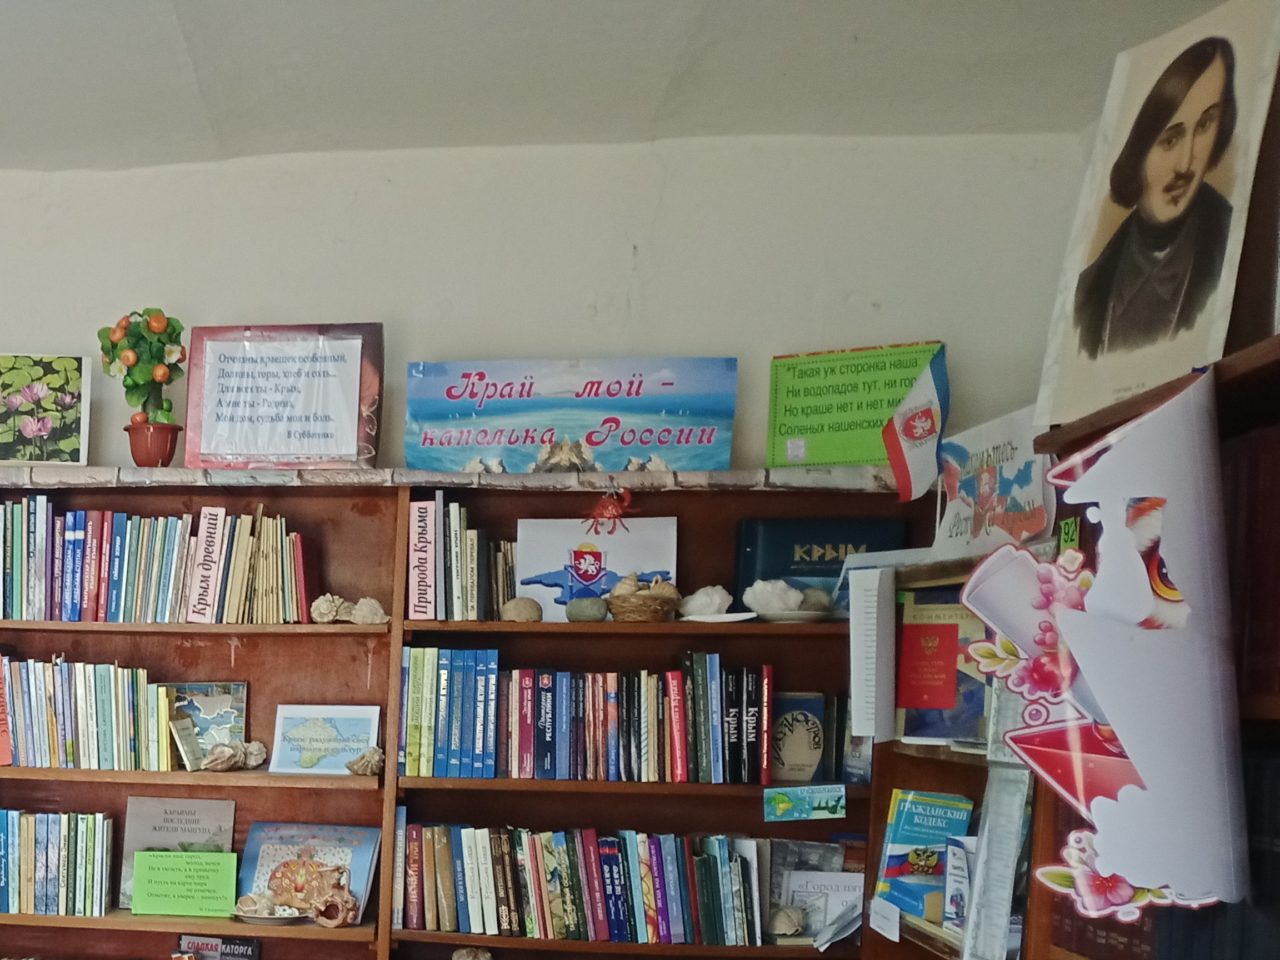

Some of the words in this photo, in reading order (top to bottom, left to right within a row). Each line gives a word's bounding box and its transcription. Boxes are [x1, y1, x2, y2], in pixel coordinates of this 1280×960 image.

[824, 367, 836, 379] уж
[839, 363, 887, 376] сторонка
[445, 370, 535, 409] Край
[574, 373, 644, 398] мой
[786, 386, 800, 398] Ни
[804, 383, 858, 397] водопадов
[884, 378, 896, 388] ни
[784, 405, 798, 417] Но
[802, 404, 833, 418] краше
[837, 402, 853, 412] нет
[857, 402, 863, 410] и
[866, 399, 883, 410] нет
[420, 429, 556, 447] капелька
[585, 416, 718, 447] России
[779, 423, 824, 436] Соленых
[828, 419, 884, 432] нашенских
[200, 508, 223, 567] древний
[413, 506, 432, 554] Крыма
[1062, 521, 1077, 544] 92
[191, 570, 215, 618] Крым
[412, 557, 432, 615] Природа
[727, 708, 738, 742] Крым
[747, 707, 758, 742] Крым
[900, 802, 968, 820] ГРАЖДАНСКИЙ
[913, 815, 949, 828] КОДЕКС
[187, 941, 218, 952] СЛАДКАЯ
[221, 945, 252, 955] КАТОРГА
